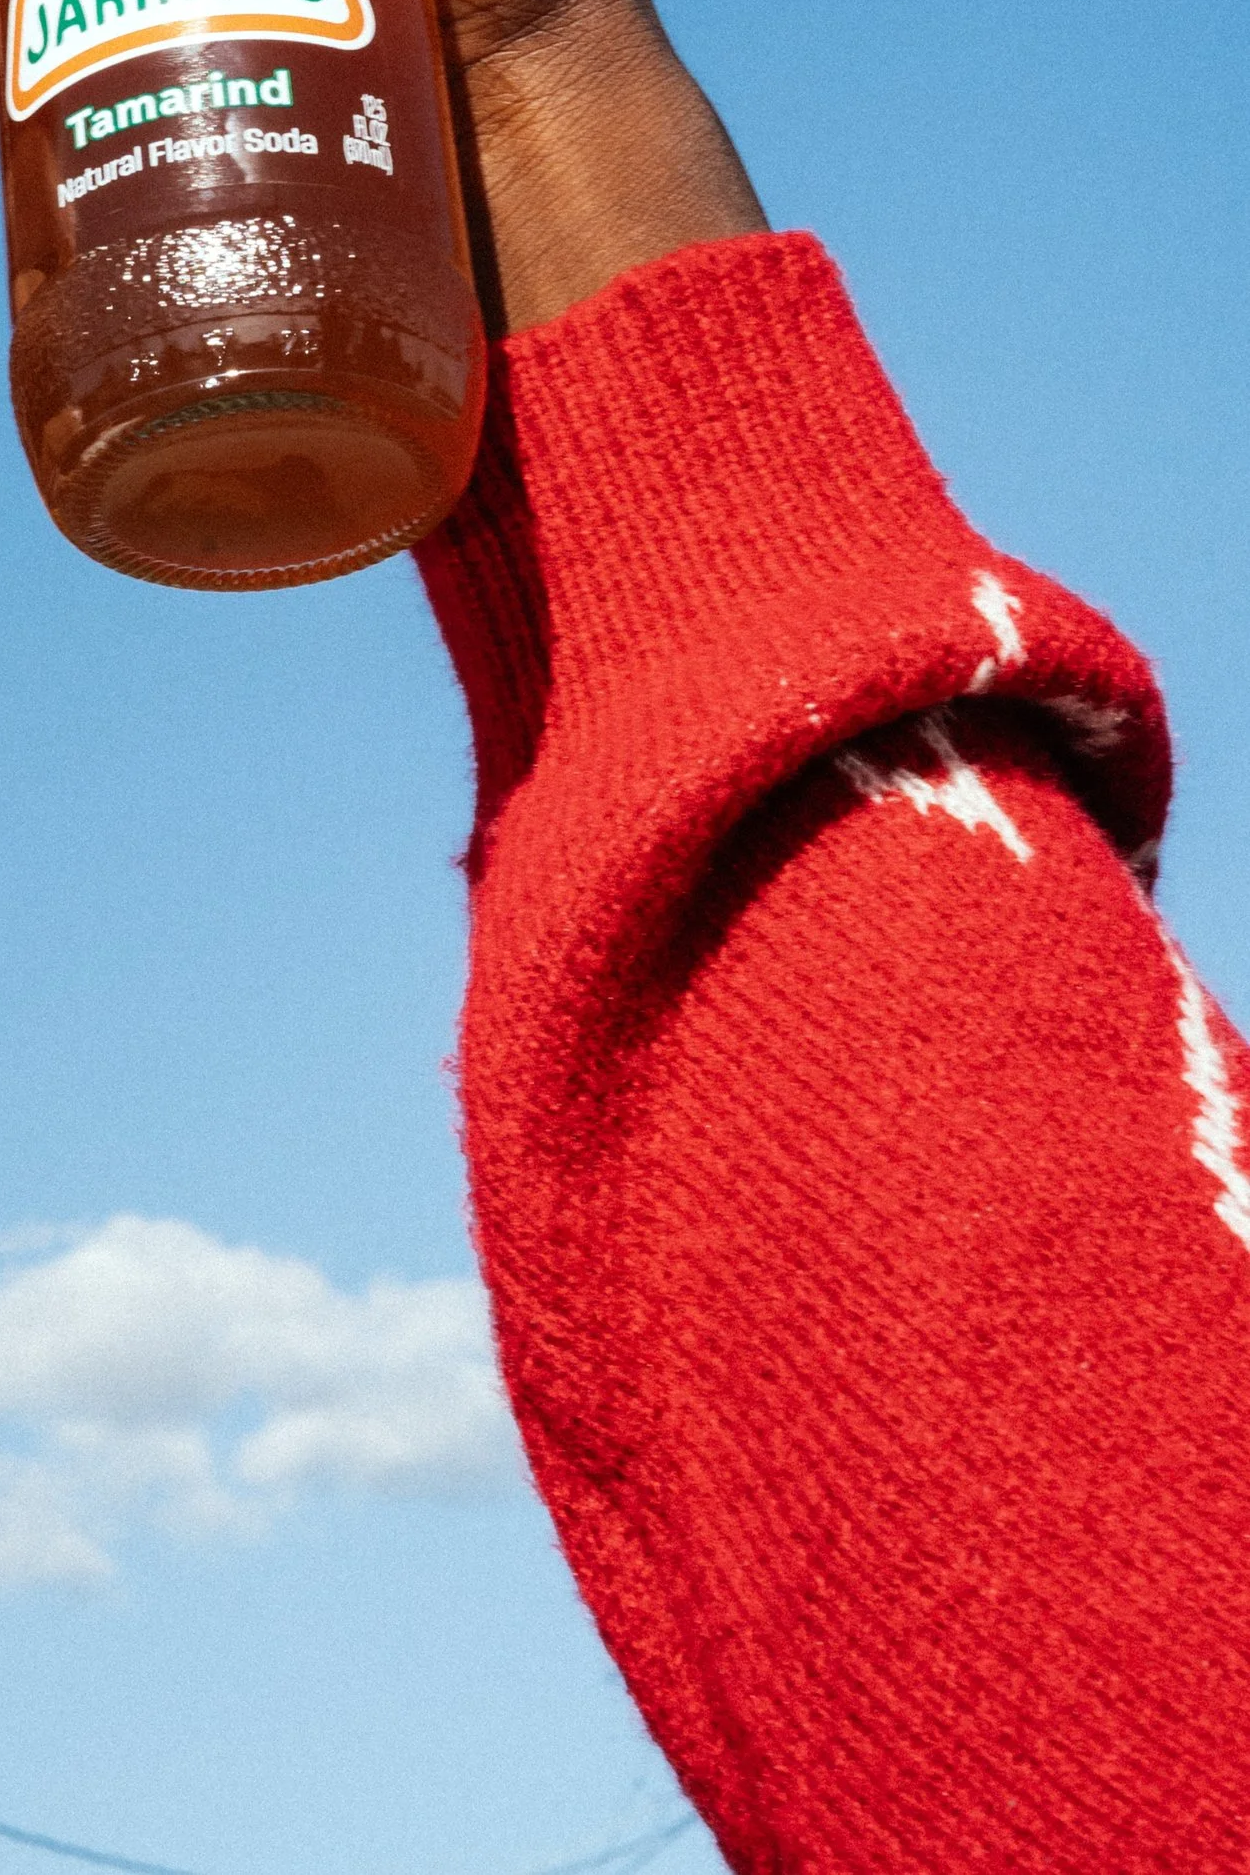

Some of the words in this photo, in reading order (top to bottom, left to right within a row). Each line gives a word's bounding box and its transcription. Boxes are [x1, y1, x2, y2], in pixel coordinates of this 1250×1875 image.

[64, 67, 294, 151] Tamarind
[56, 145, 144, 209] Natural
[147, 136, 236, 167] Flavor
[242, 126, 320, 156] Soda
